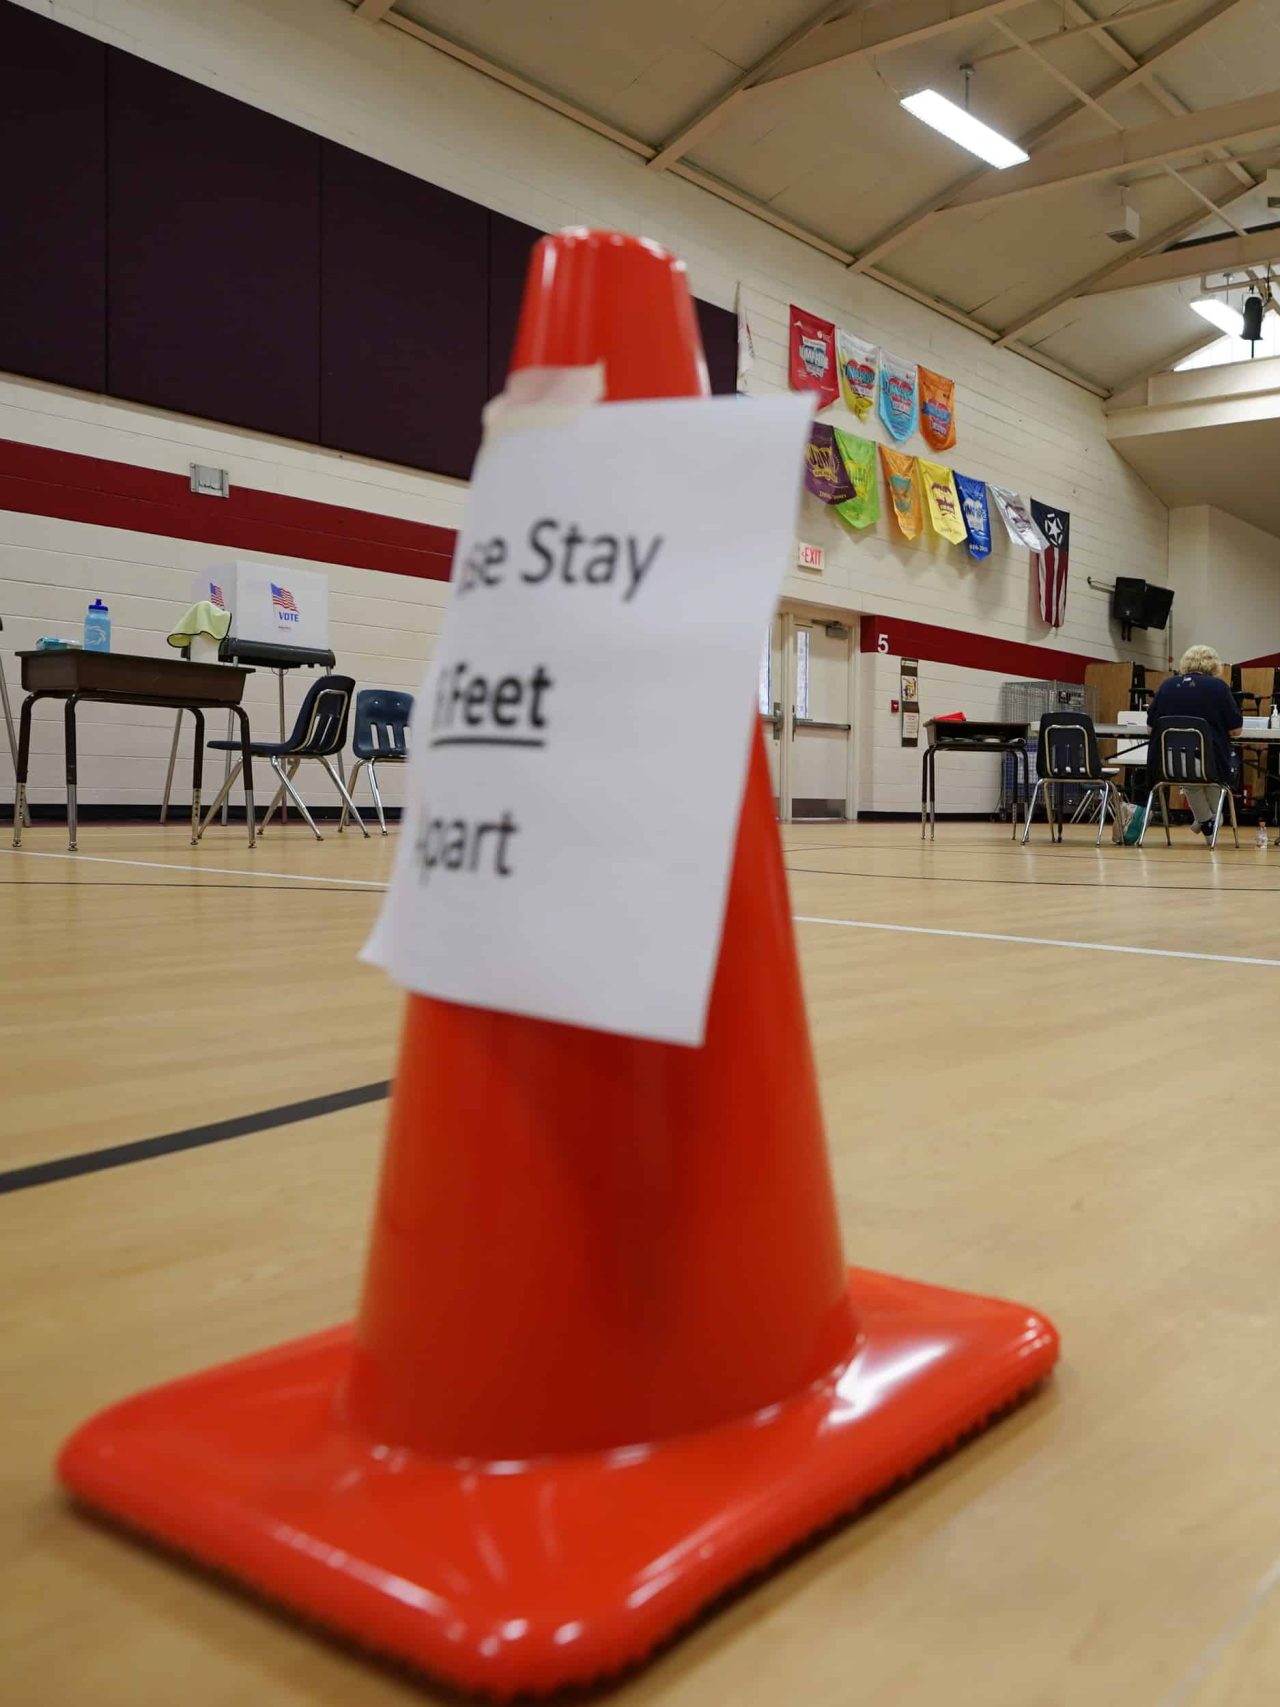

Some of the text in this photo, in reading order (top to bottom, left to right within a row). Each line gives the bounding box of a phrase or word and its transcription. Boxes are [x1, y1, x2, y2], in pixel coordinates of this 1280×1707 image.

[520, 517, 664, 602] Stay
[804, 547, 822, 566] EXIT
[279, 612, 299, 622] VOTE
[877, 633, 889, 653] 5
[416, 808, 518, 888] part
